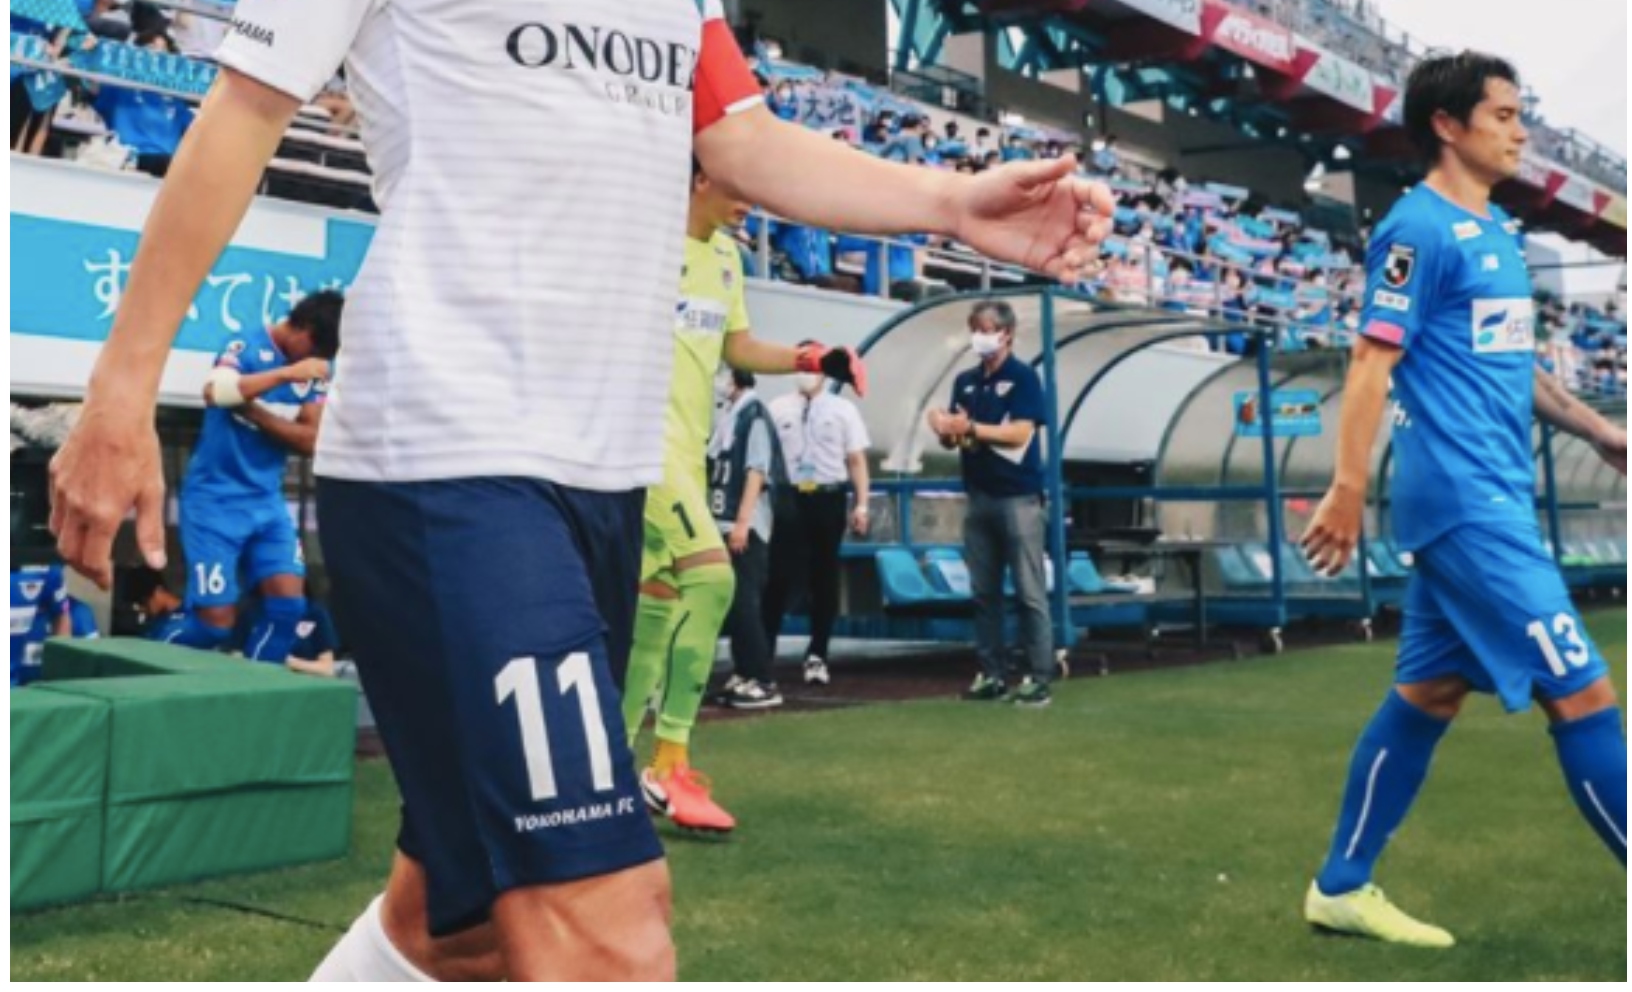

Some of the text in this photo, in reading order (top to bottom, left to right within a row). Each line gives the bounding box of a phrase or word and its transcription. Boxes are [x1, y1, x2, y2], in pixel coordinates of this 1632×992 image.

[506, 22, 699, 91] ONODE
[671, 501, 696, 540] 1
[194, 561, 227, 597] 16
[1526, 612, 1589, 676] 13
[494, 651, 615, 802] 11
[514, 797, 635, 833] YOKOHAMA FC
